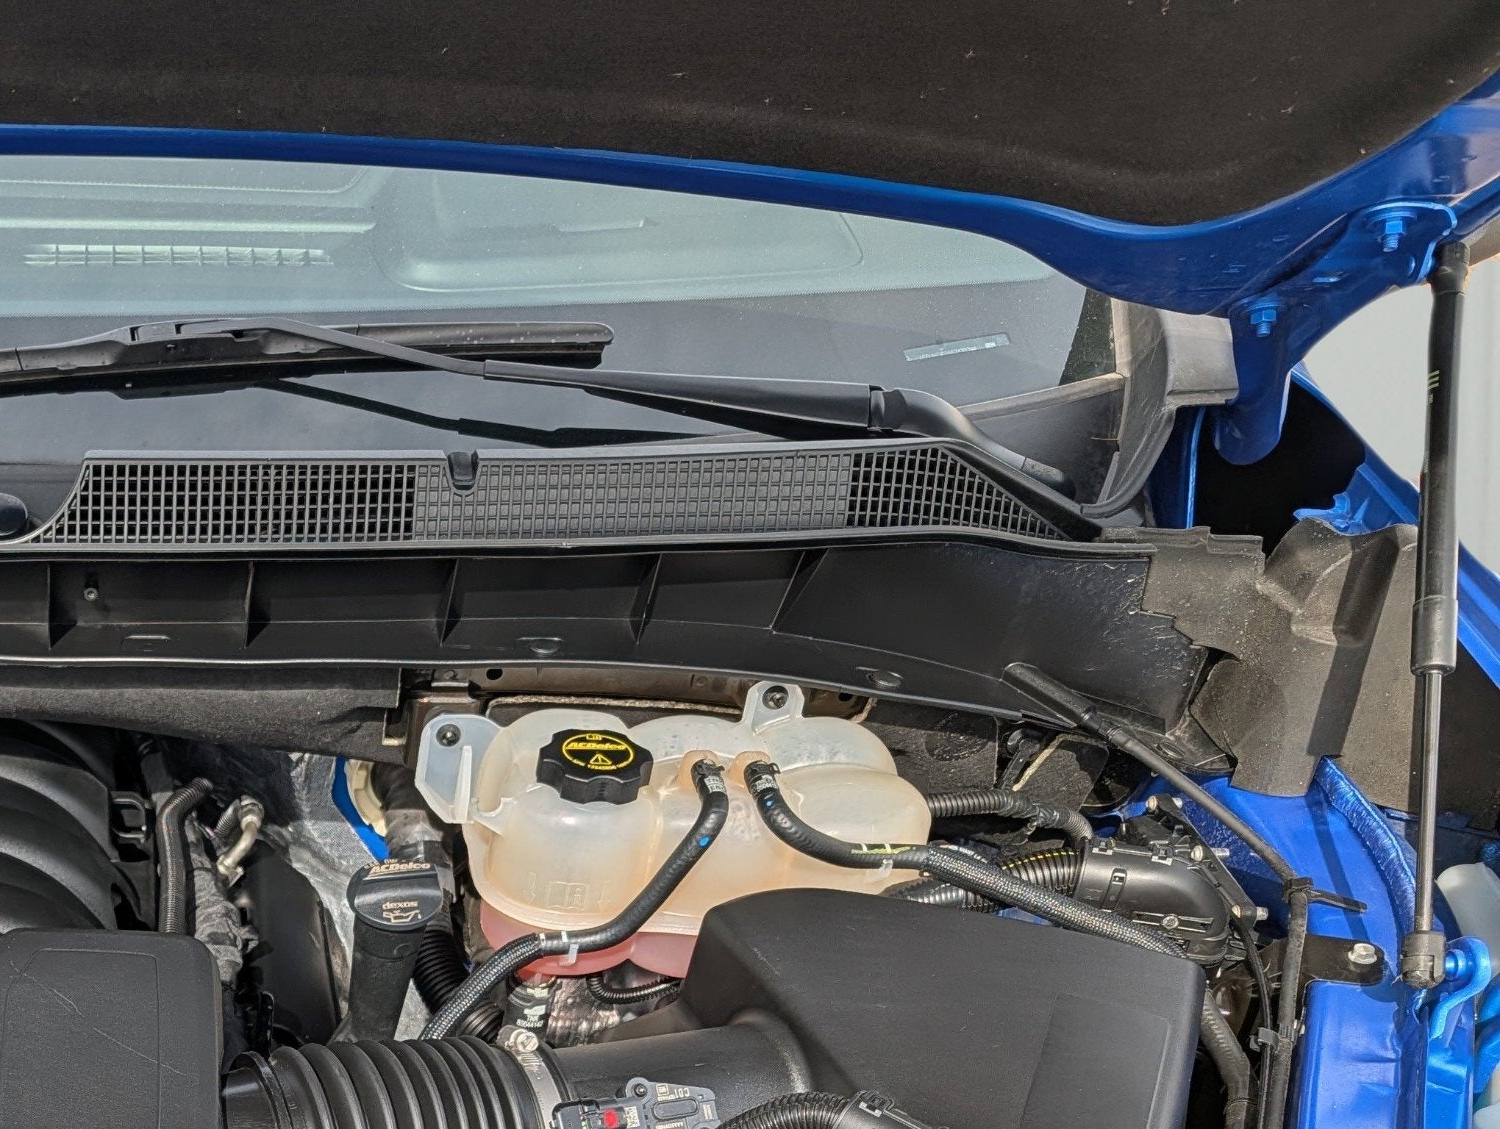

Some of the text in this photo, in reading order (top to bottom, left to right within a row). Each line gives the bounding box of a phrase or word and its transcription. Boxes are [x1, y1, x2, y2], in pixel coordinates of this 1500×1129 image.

[565, 742, 627, 751] ACDelco
[369, 862, 431, 875] ACDelco
[382, 901, 419, 910] dexos
